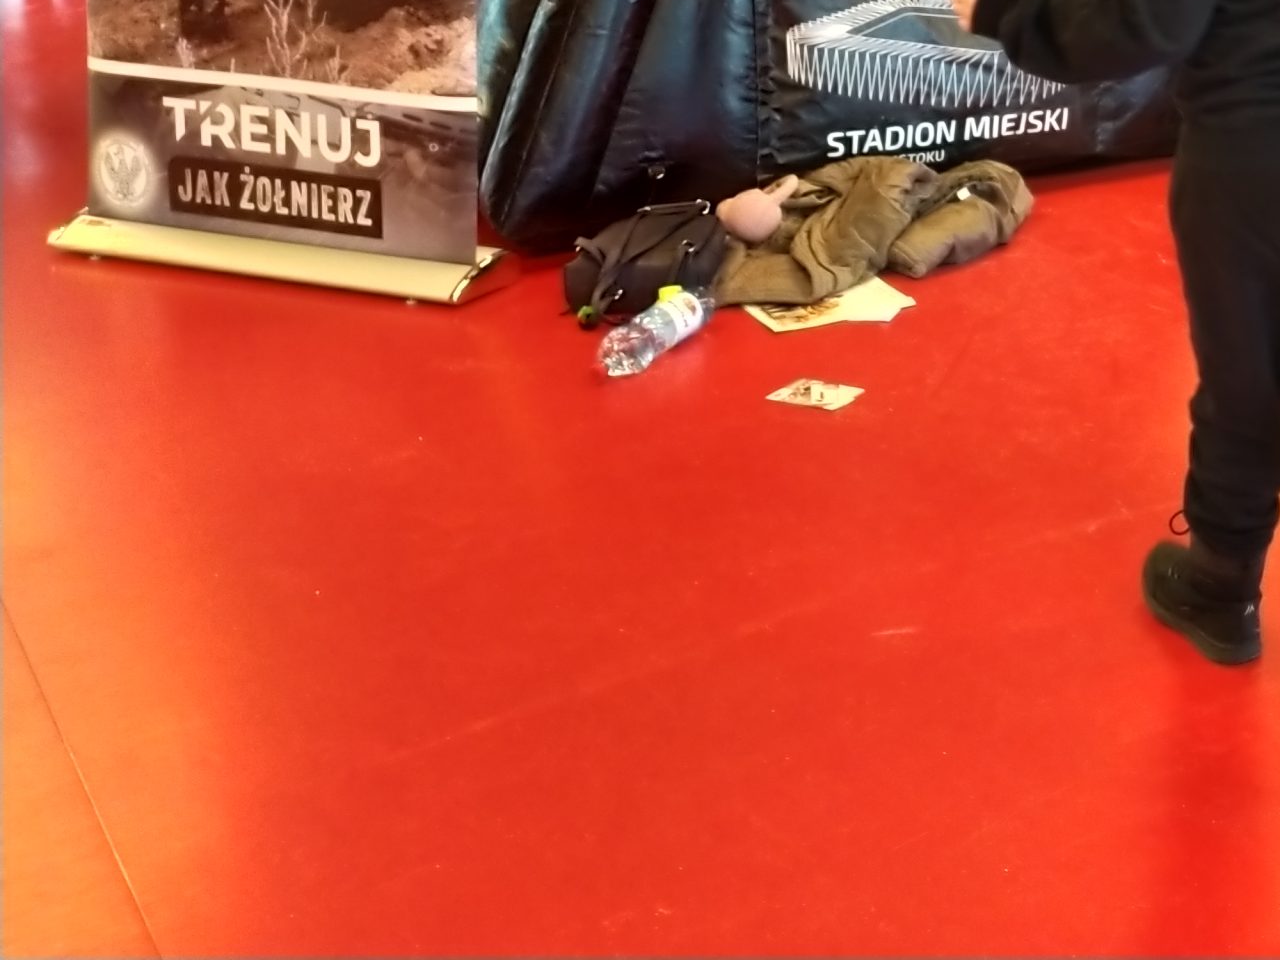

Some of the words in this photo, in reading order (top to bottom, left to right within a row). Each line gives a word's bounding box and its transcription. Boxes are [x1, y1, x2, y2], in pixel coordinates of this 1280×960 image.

[162, 96, 382, 167] TRENUJ
[826, 119, 957, 158] STADION
[963, 107, 1070, 142] MIEJSKI
[178, 169, 230, 208] JAK
[239, 165, 373, 227] ŻOŁNIERZ
